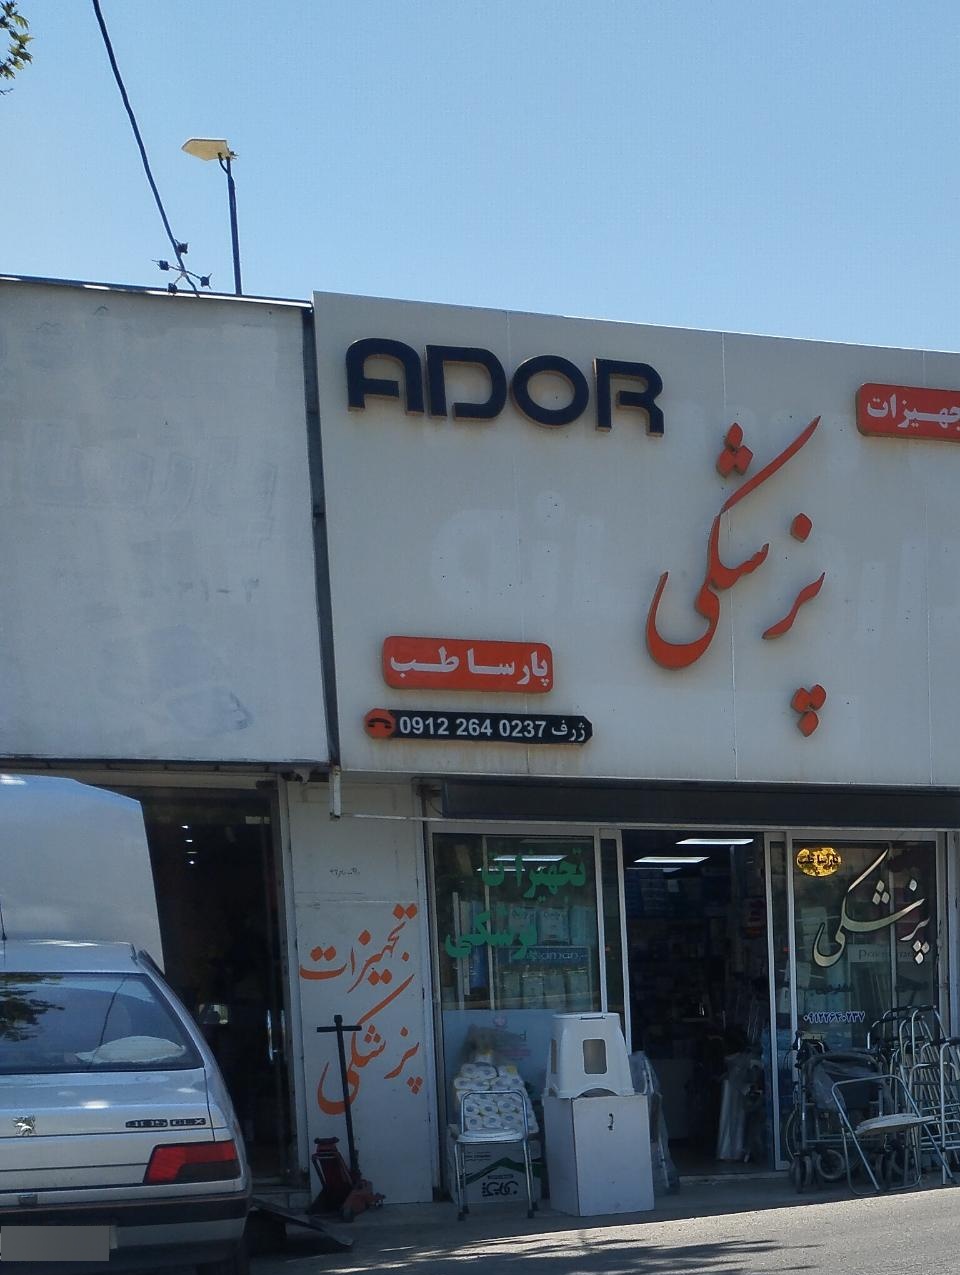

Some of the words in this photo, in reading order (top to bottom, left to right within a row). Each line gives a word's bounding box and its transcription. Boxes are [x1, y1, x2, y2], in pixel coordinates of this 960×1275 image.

[345, 337, 665, 437] ADOR
[646, 416, 827, 738] پزشکی
[390, 646, 460, 679] طب
[466, 648, 549, 687] پارسا
[400, 716, 449, 735] 0912
[456, 718, 492, 736] 264
[499, 719, 546, 738] 0237
[551, 719, 585, 741] ژرف
[482, 848, 586, 904] تجهیزات
[812, 848, 930, 968] پزشکی
[299, 903, 418, 994] تجهیزات
[317, 974, 423, 1115] پزشکی
